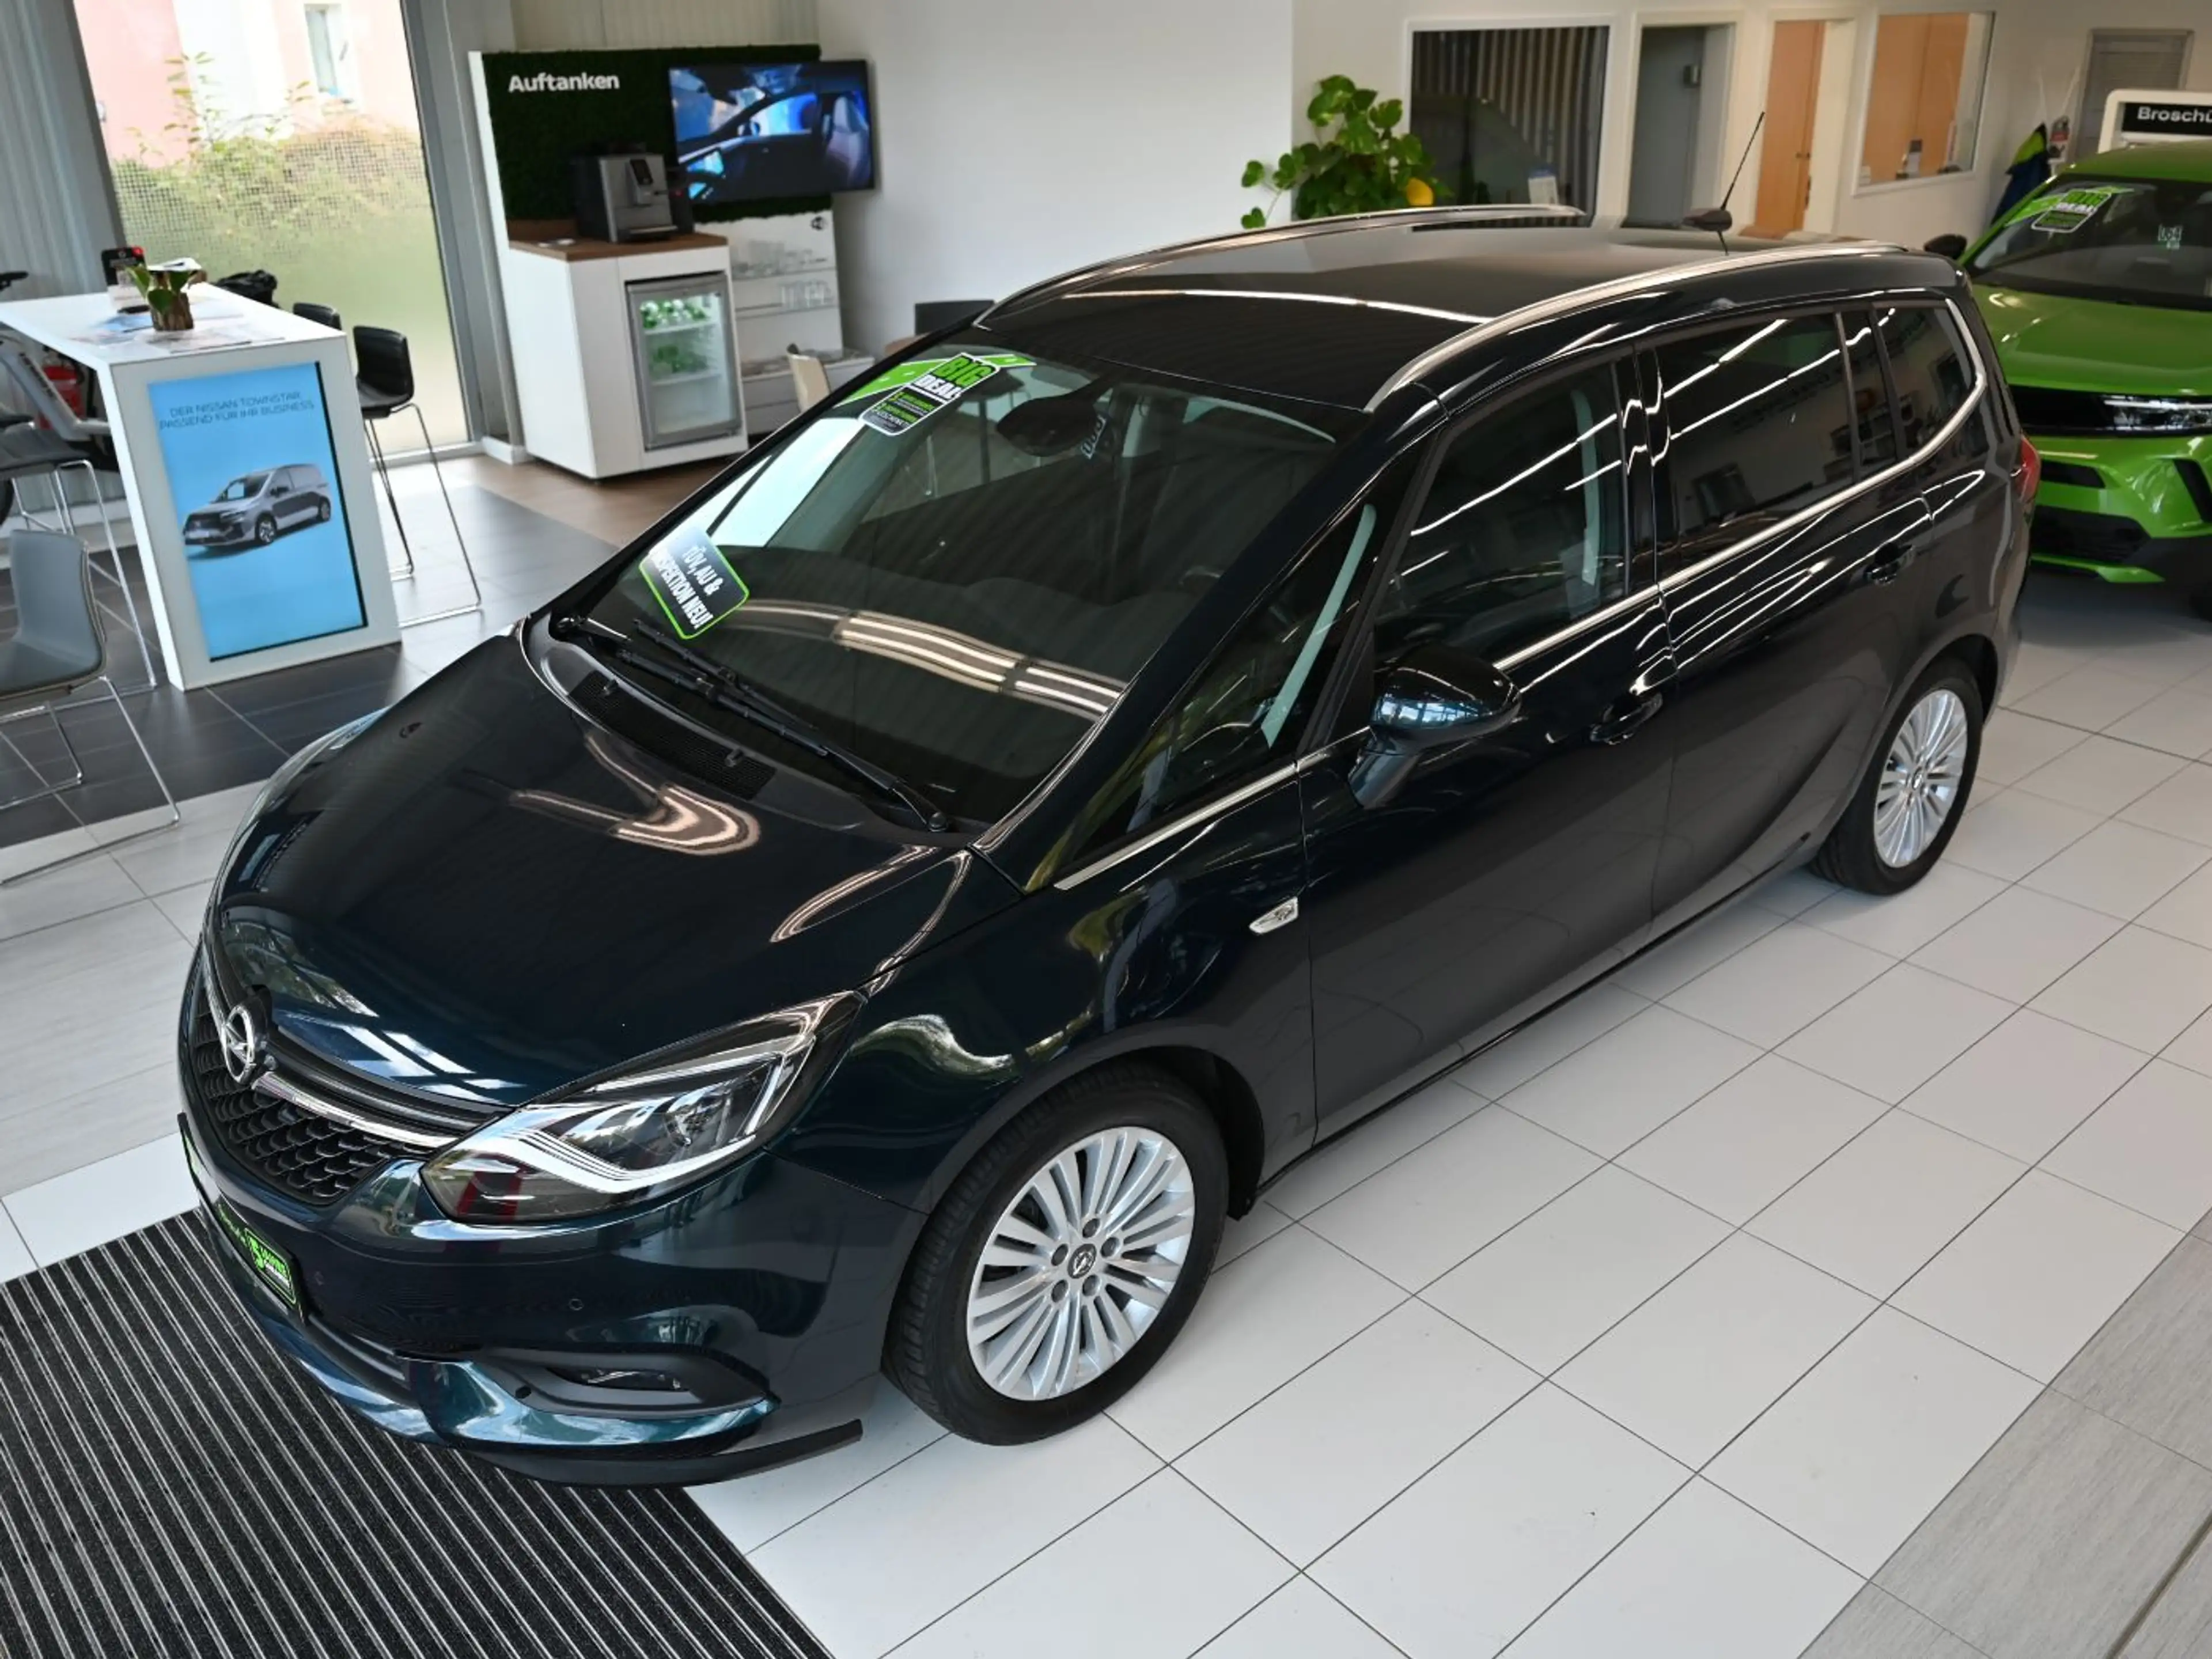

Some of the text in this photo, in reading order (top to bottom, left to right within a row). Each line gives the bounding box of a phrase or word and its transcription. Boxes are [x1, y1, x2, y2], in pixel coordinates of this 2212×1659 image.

[508, 71, 620, 93] Auftanken
[932, 357, 993, 388] BIG
[694, 564, 718, 586] AU
[703, 577, 724, 597] &
[681, 594, 714, 630] NEU!
